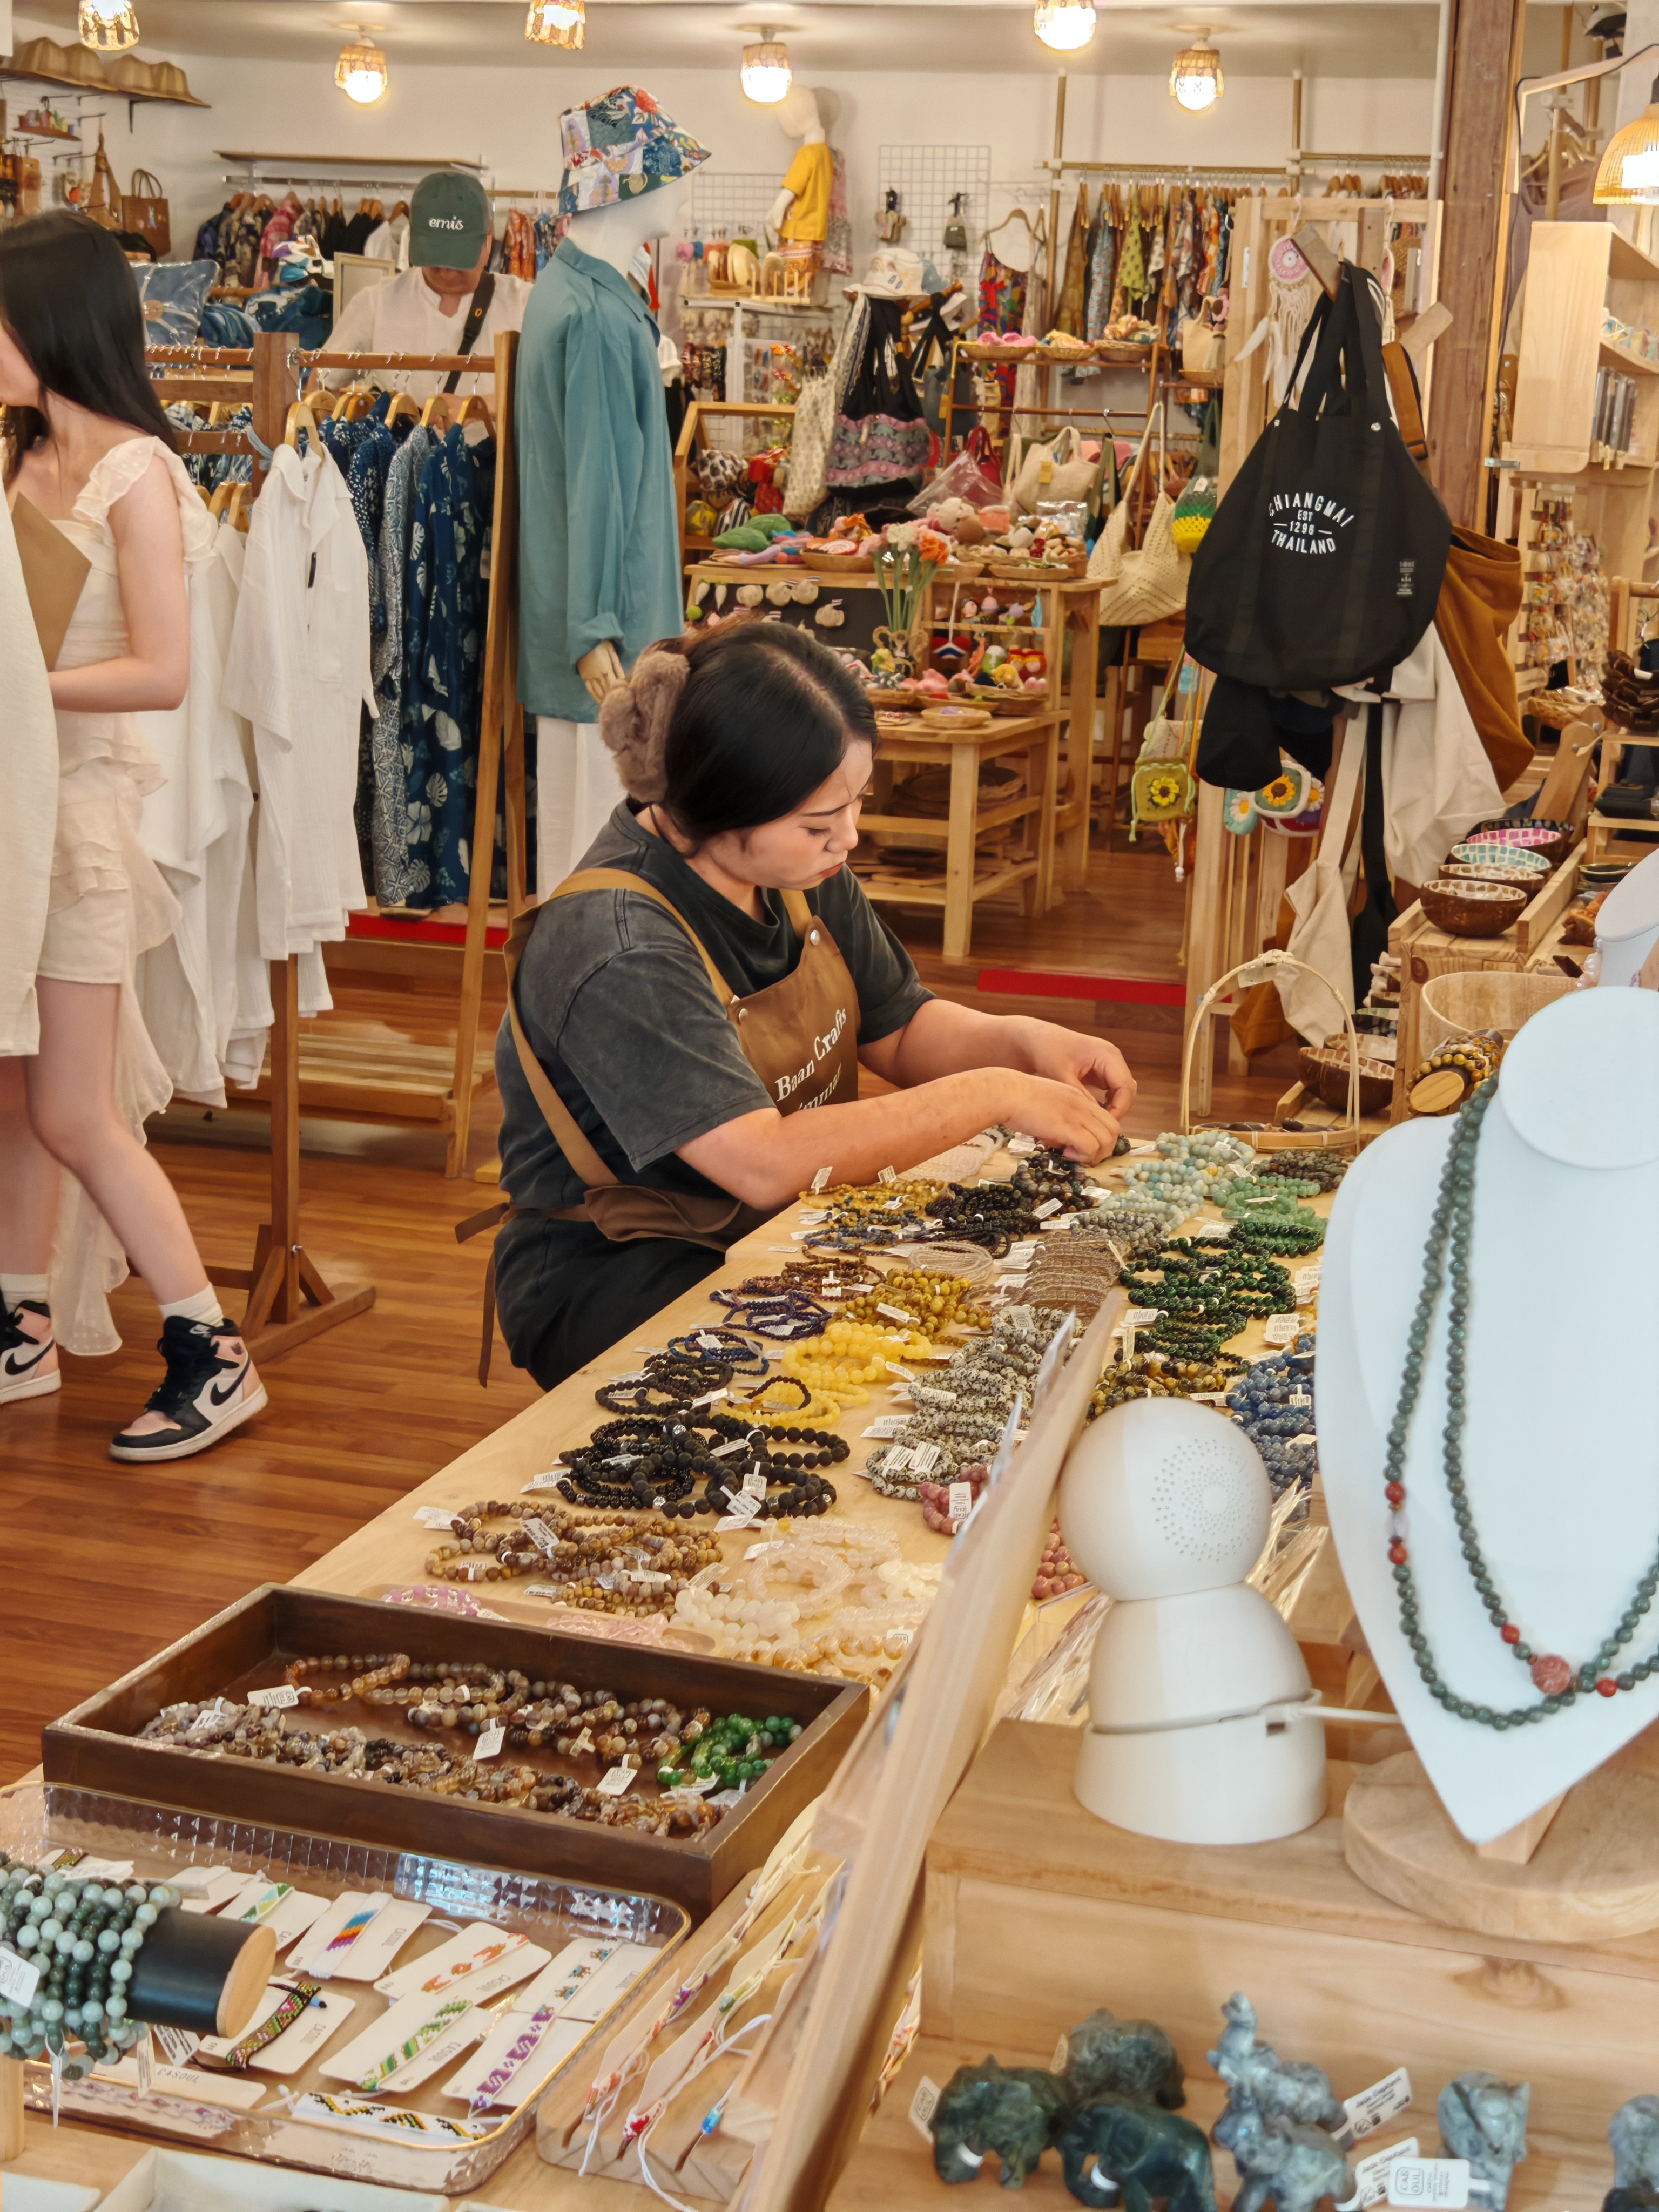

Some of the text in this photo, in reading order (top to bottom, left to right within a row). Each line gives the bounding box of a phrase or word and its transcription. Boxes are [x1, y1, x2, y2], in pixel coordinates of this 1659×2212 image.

[429, 215, 464, 230] emis
[1297, 509, 1313, 522] EST
[1290, 521, 1315, 535] 1296
[1271, 529, 1336, 554] THAILAND
[775, 1008, 846, 1102] Baan Crafts
